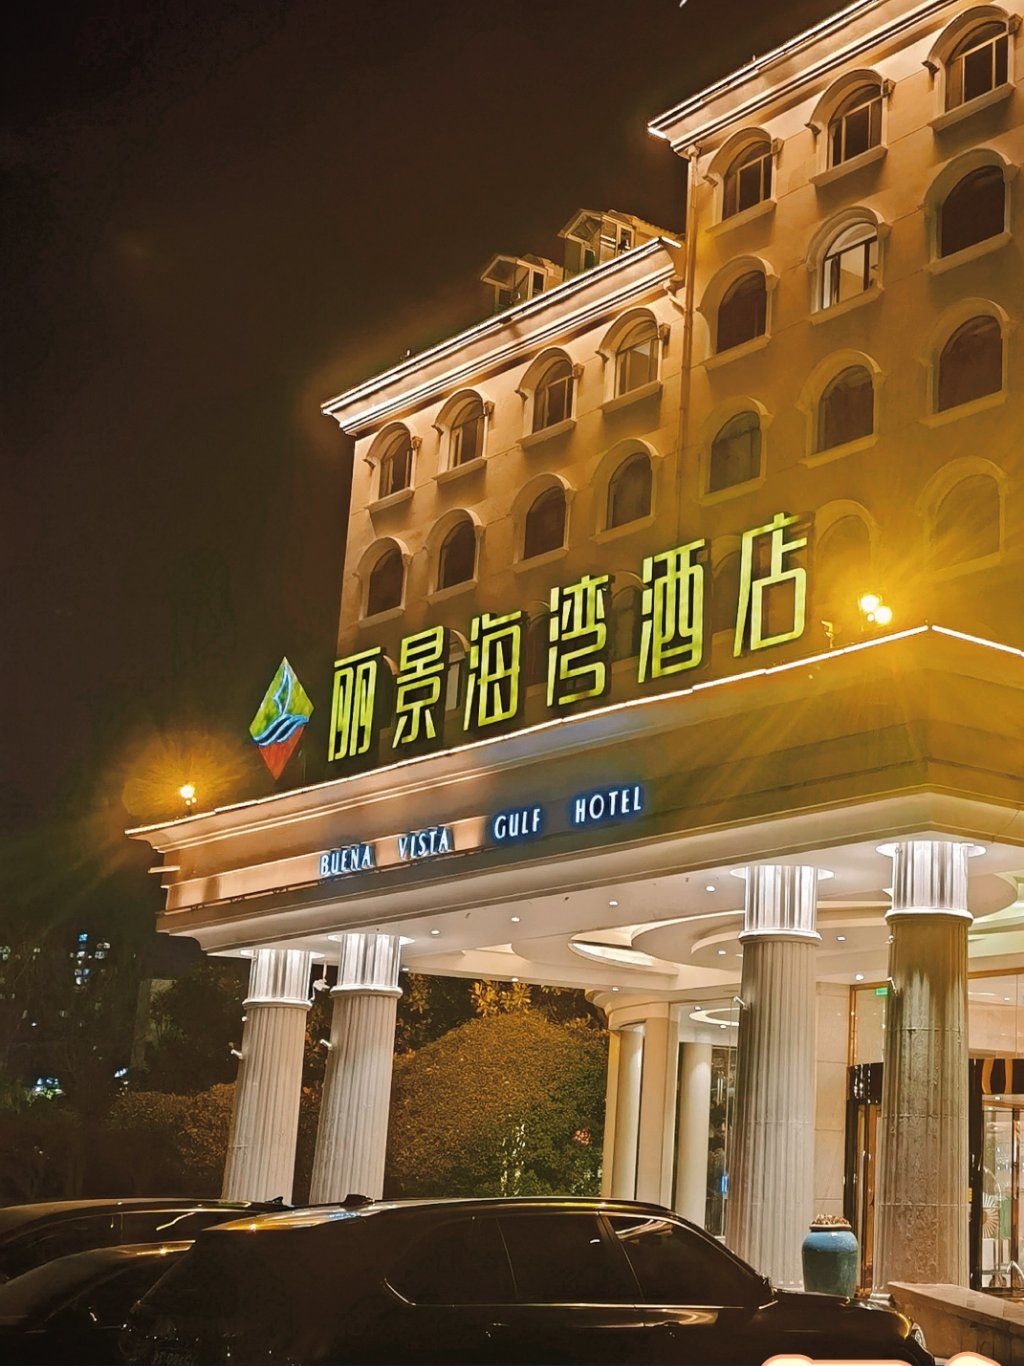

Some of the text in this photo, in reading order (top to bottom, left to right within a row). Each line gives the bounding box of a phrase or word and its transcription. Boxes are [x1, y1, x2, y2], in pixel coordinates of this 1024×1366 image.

[327, 511, 808, 764] 丽景海湾酒店
[319, 786, 642, 878] BUENA VISTA GULF HOTEL
